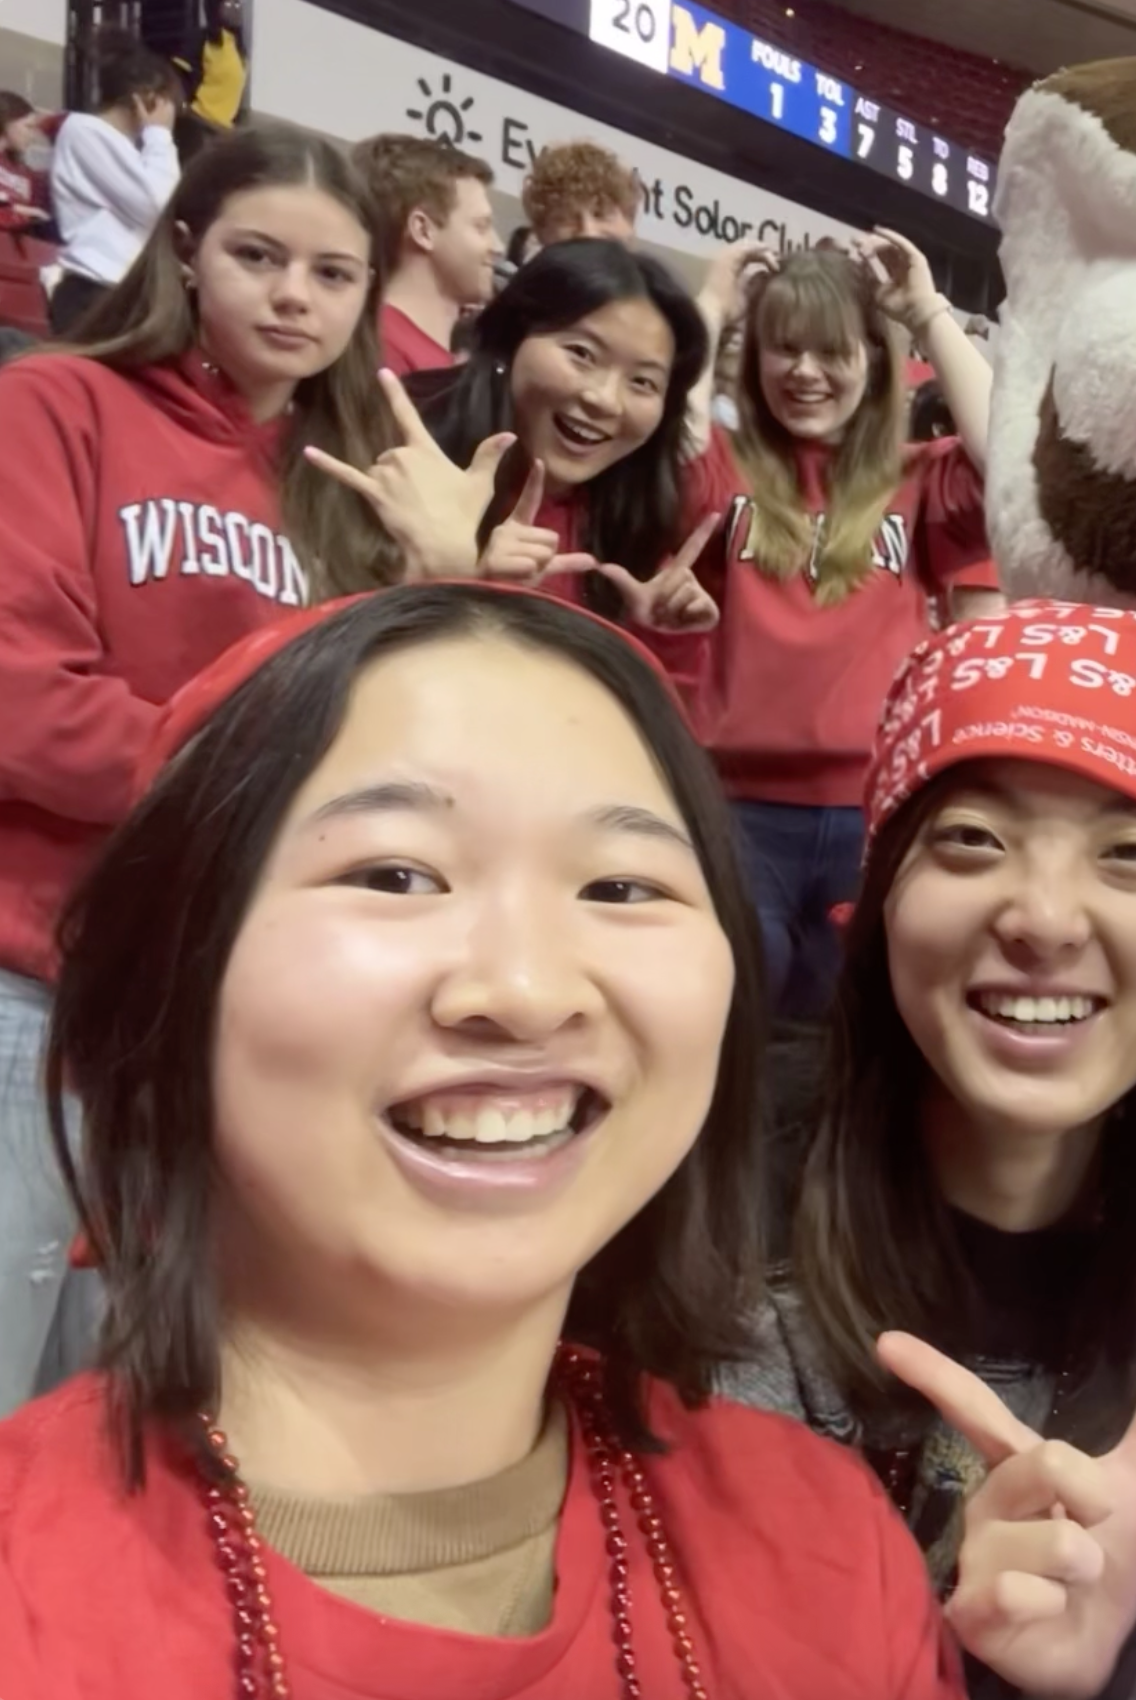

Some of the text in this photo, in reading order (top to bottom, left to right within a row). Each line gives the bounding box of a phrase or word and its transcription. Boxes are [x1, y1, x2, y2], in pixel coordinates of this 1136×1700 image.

[611, 0, 656, 43] 20
[669, 3, 726, 91] M
[751, 39, 845, 106] FOULS TOL
[770, 82, 838, 144] 1 3
[854, 97, 881, 122] AST
[896, 117, 918, 144] STL
[932, 136, 950, 159] TO
[857, 123, 989, 216] 7 5 8 12
[1020, 623, 1120, 656] L&S
[951, 652, 1048, 691] L&S
[1053, 729, 1076, 748] &
